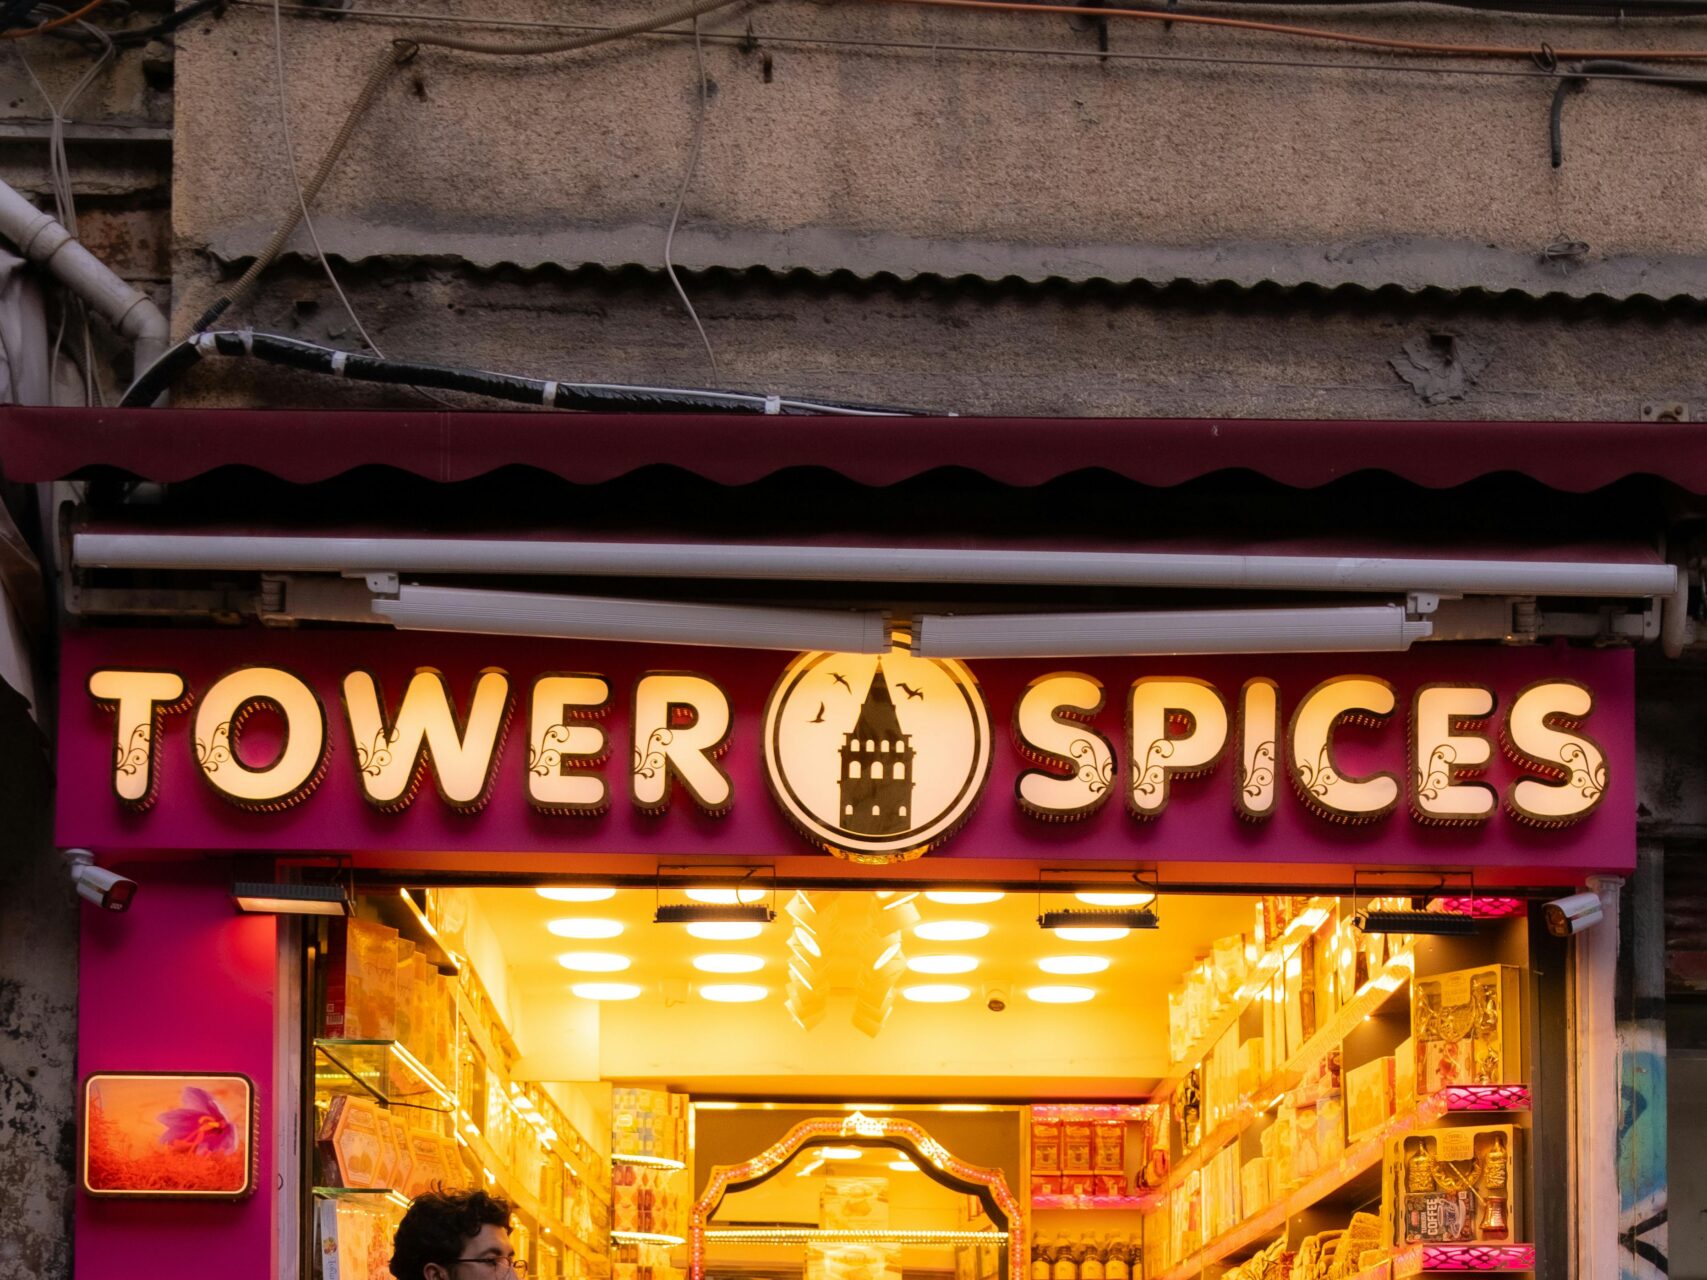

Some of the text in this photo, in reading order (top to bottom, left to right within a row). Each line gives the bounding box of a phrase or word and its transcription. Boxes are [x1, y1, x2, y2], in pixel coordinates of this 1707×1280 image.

[86, 666, 1610, 826] TOWER SPICES
[1427, 1199, 1438, 1236] COFFEE
